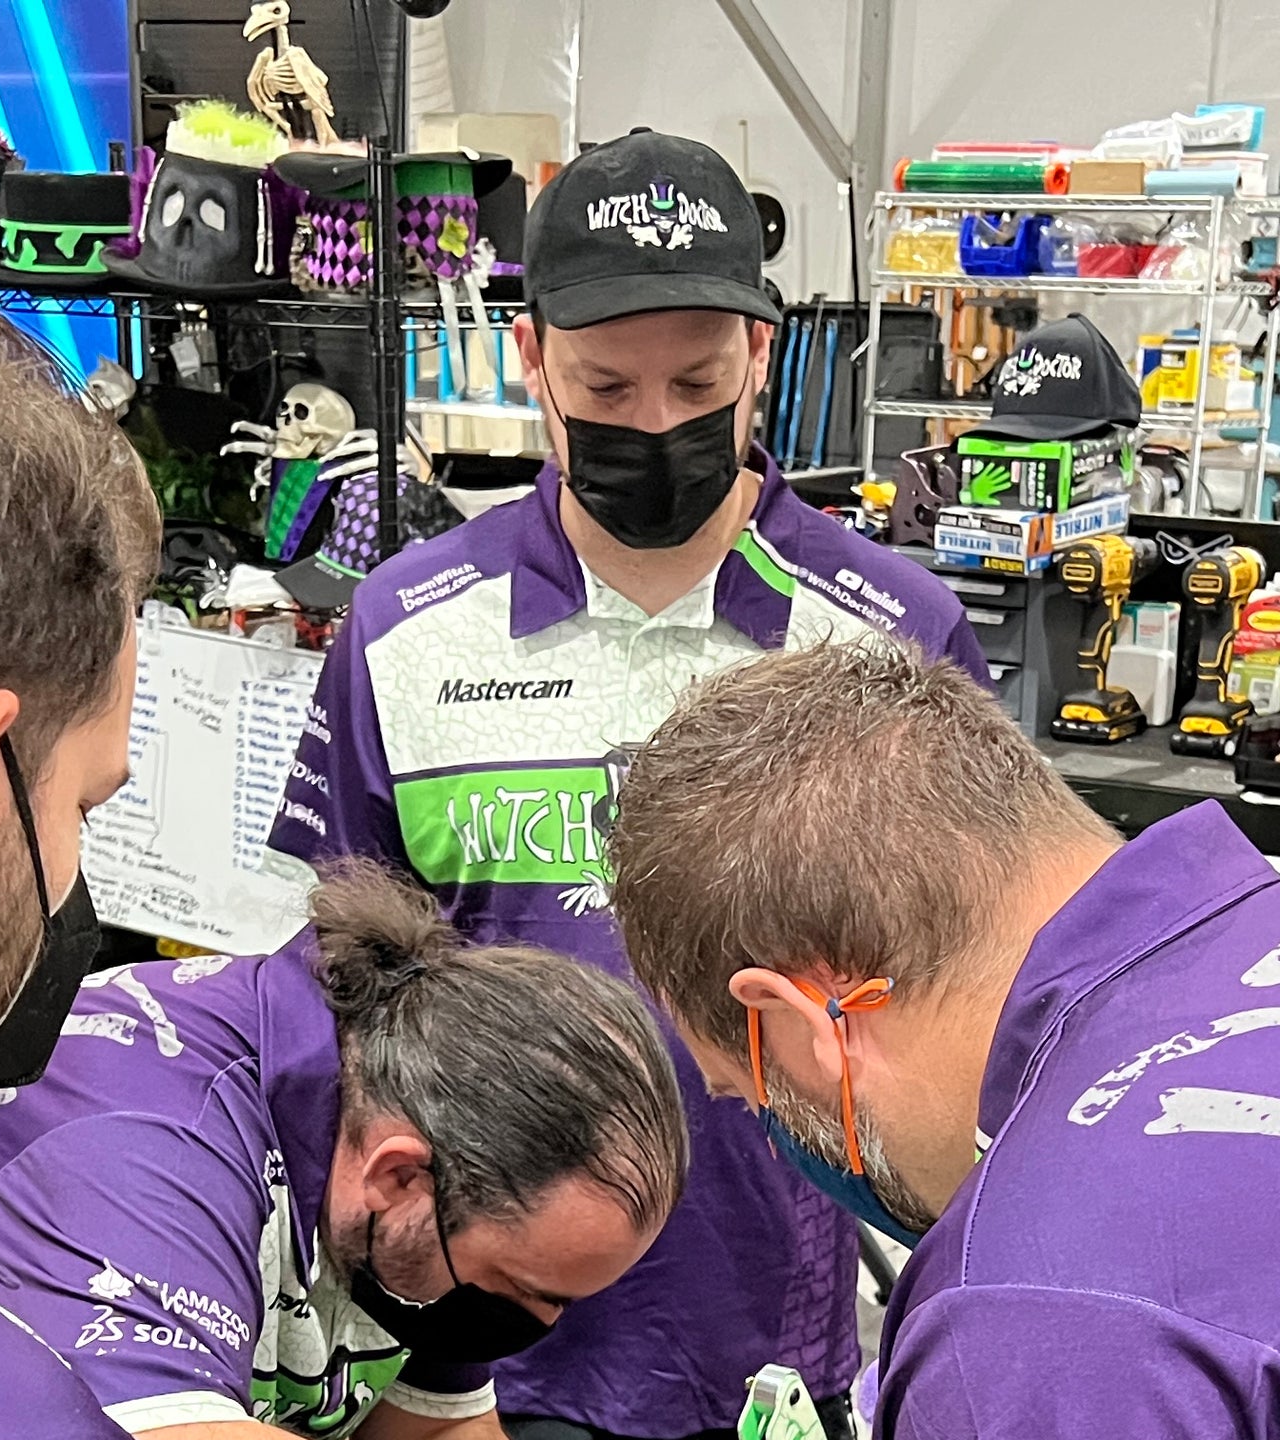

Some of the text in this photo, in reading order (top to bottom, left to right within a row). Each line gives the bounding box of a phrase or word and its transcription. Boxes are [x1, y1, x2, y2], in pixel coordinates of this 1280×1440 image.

[587, 194, 650, 231] WITCH
[1055, 513, 1103, 540] NITRILE
[402, 571, 483, 612] Doctor.com
[860, 580, 907, 618] YouTube
[437, 676, 573, 706] Mastercam
[447, 786, 599, 866] WITCH
